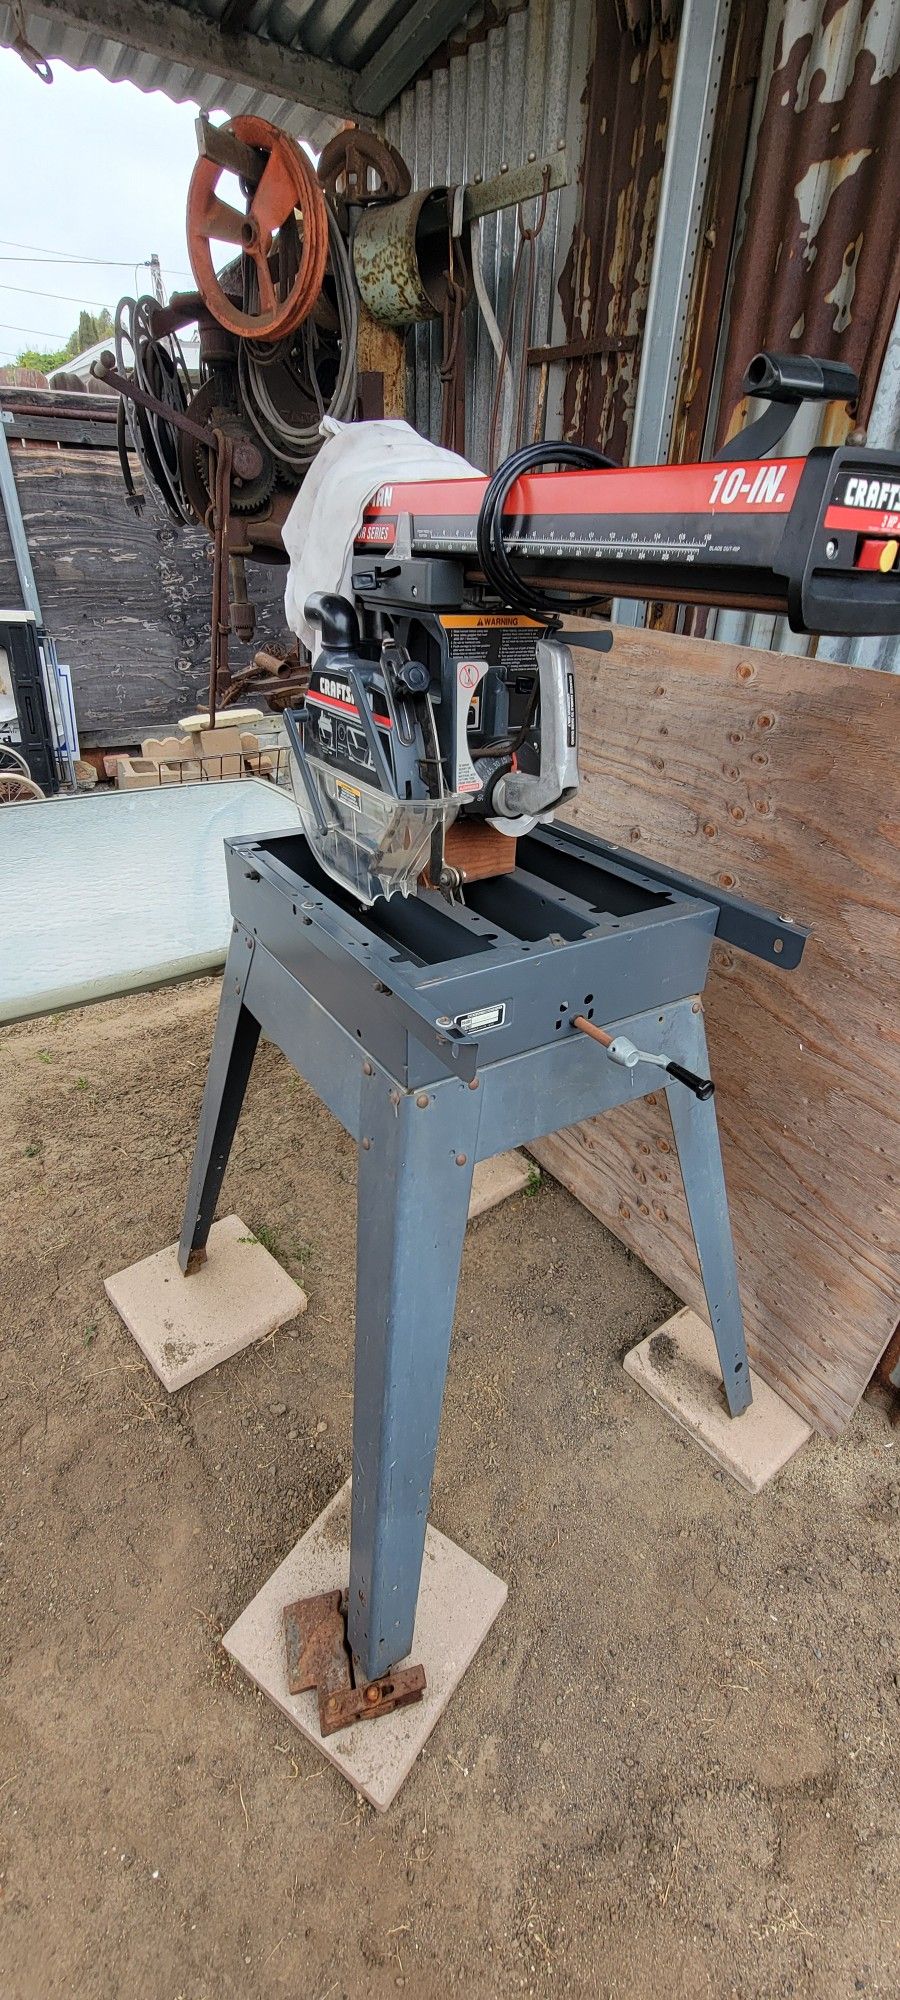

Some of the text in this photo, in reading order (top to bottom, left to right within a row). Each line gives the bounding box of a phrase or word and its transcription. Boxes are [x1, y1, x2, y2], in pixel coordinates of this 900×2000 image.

[708, 465, 788, 504] 10-IN.
[367, 526, 389, 540] SERIES
[484, 617, 518, 626] WARNING
